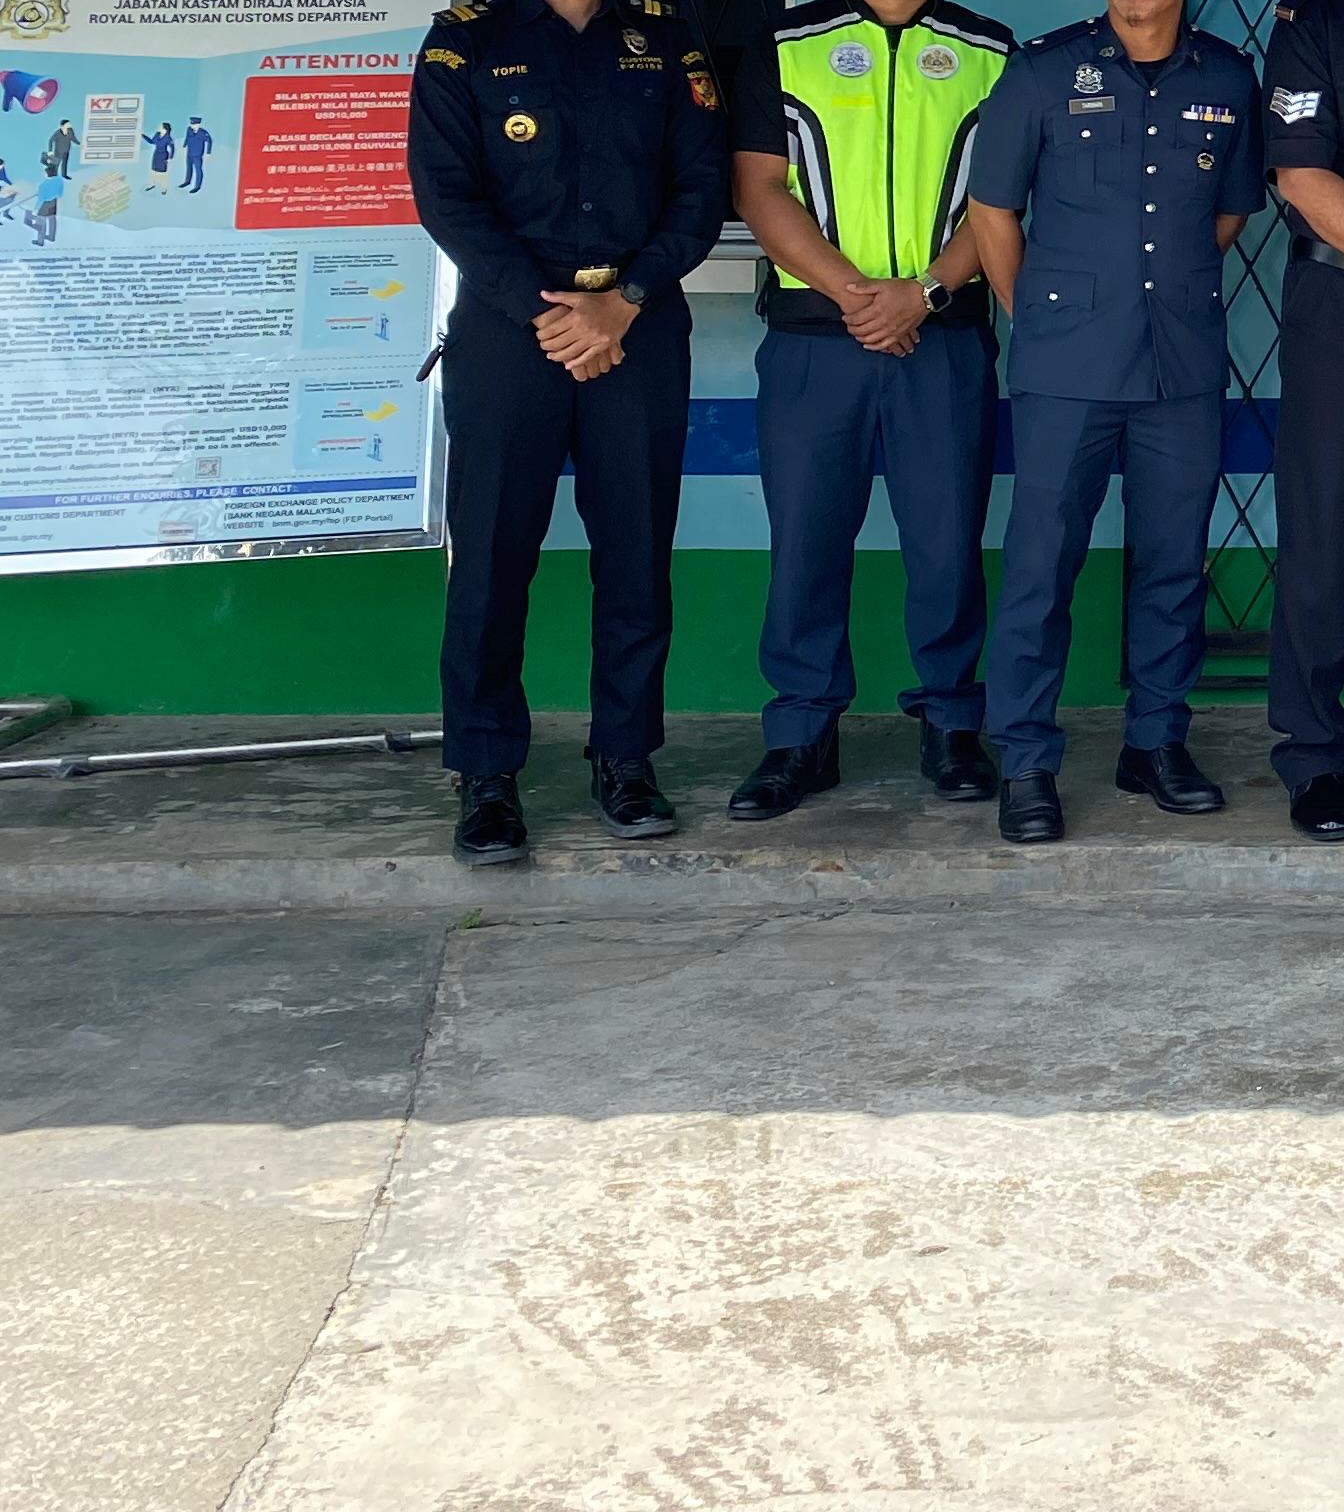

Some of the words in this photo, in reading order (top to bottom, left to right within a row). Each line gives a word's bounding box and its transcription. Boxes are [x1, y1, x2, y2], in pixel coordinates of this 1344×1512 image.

[114, 0, 178, 9] JABATAN
[181, 0, 239, 9] KASTAM
[89, 13, 135, 24] ROYAL
[139, 13, 222, 24] MALAYSIAN
[225, 13, 294, 23] CUSTOMS
[298, 11, 388, 22] DEPARTMENT
[259, 54, 399, 70] ATTENTION
[91, 98, 113, 109] K7
[268, 134, 307, 142] PLEASE
[262, 144, 296, 153] ABOVE
[354, 142, 408, 151] EQUIVALE
[55, 496, 77, 505] FOR
[80, 493, 130, 503] FURTHER
[196, 486, 238, 497] PLEASE
[225, 501, 265, 510] FOREIGN
[268, 498, 318, 508] EXCHANGE
[320, 496, 354, 506] POLICY
[355, 493, 415, 503] DEPARTMENT
[63, 508, 127, 520] DEPARTMENT
